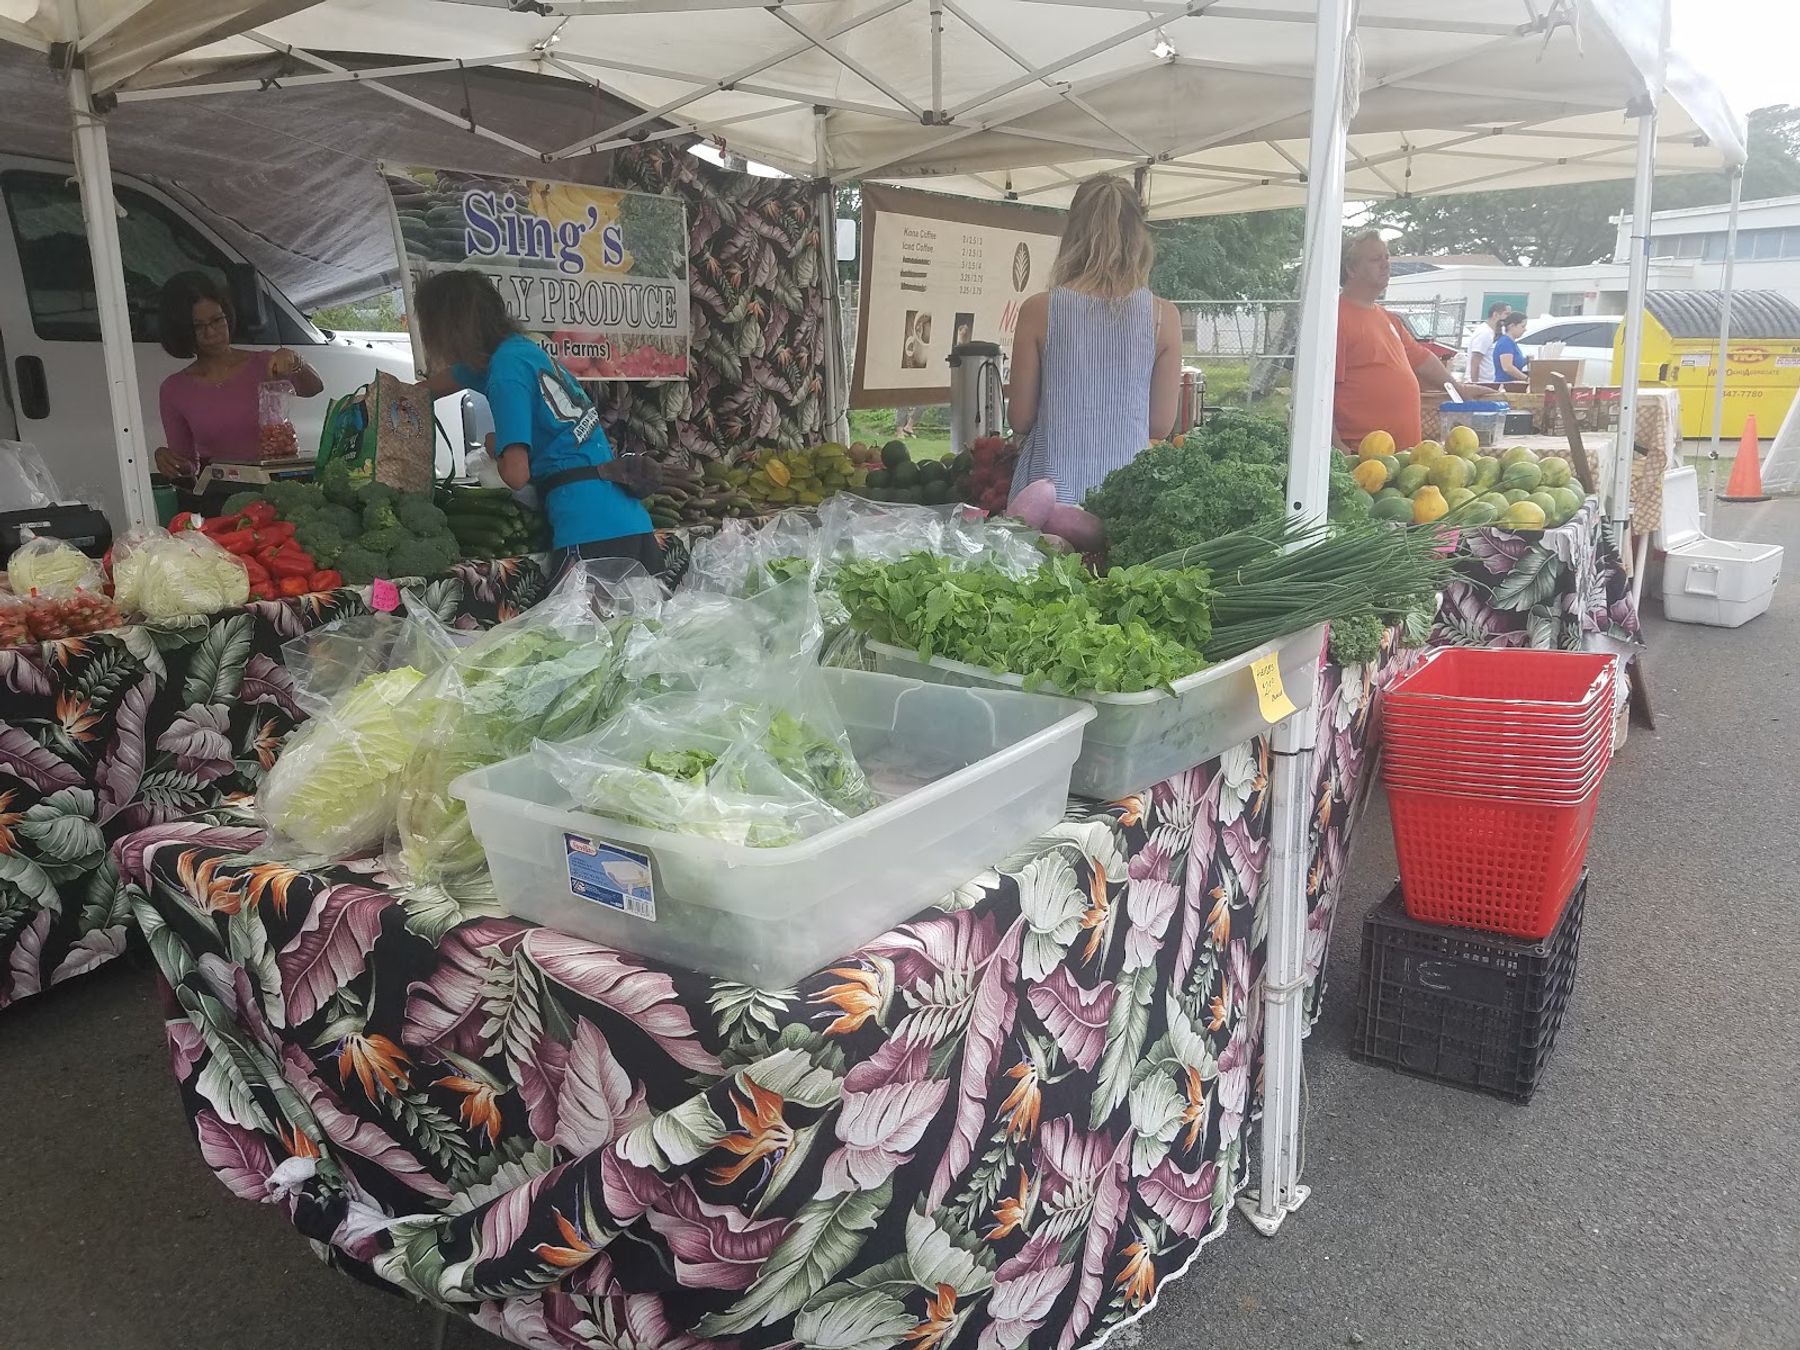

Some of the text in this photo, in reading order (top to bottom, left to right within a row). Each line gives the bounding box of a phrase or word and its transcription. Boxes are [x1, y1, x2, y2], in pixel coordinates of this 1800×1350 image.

[464, 190, 624, 274] Sing's
[903, 226, 937, 240] Kona Coffee
[902, 241, 934, 253] Iced Coffee
[541, 278, 677, 328] PRODUCE
[564, 340, 611, 360] Farms)
